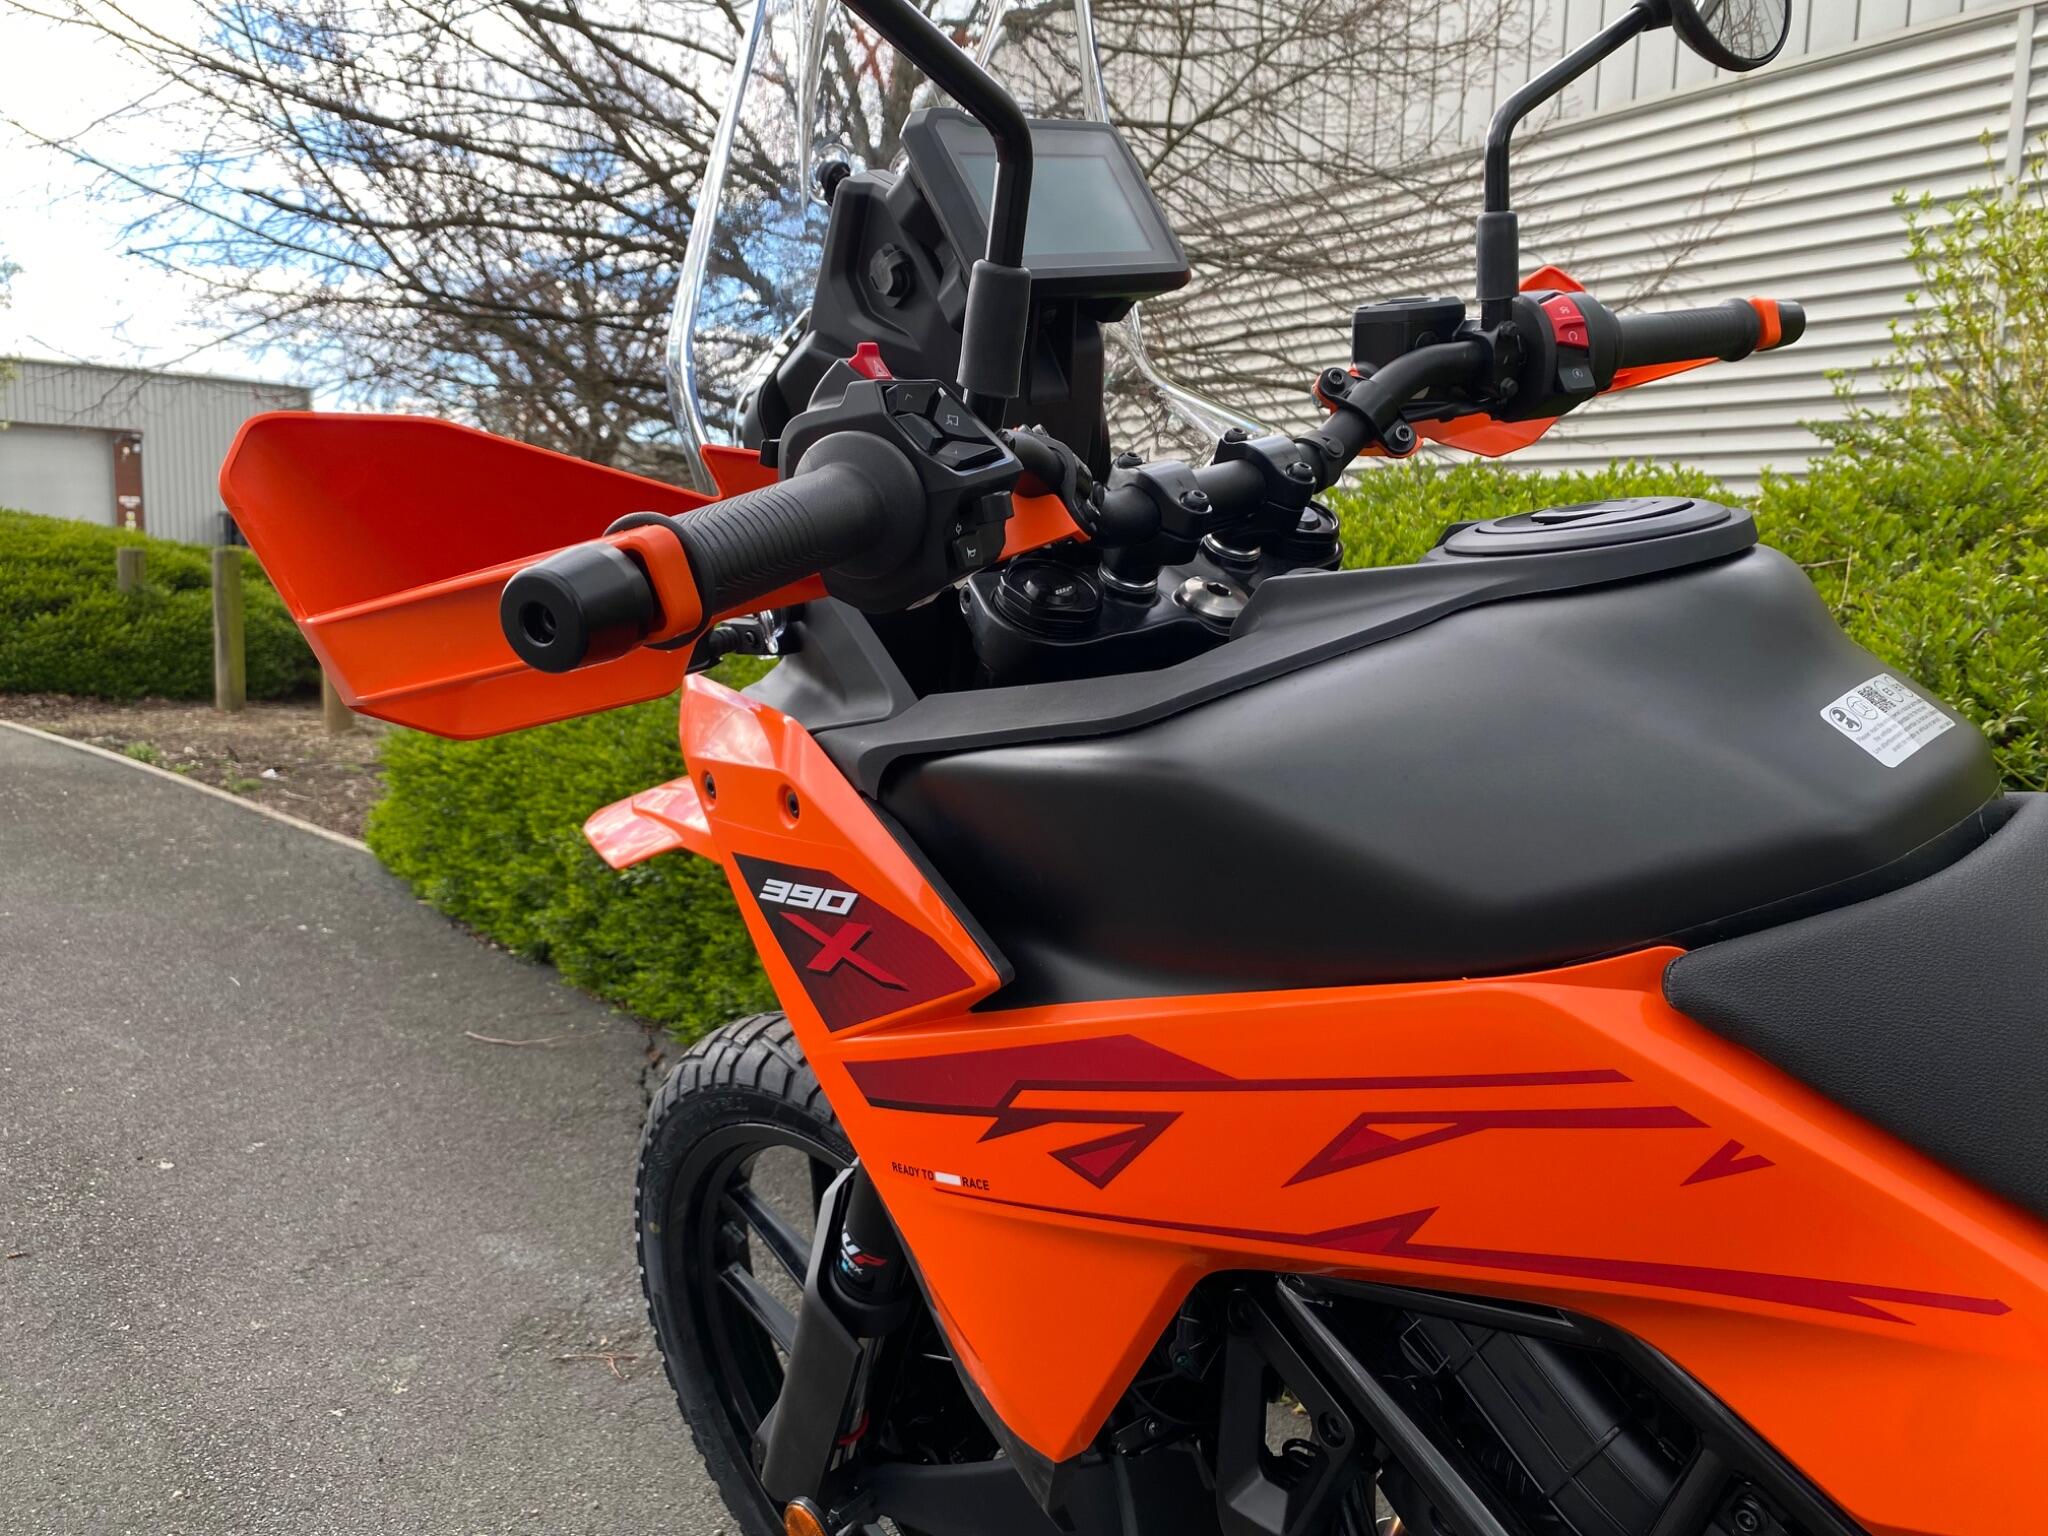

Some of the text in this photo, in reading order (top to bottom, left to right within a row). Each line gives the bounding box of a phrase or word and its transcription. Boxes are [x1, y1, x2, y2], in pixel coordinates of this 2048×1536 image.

[759, 878, 859, 916] 390
[779, 911, 909, 992] X
[891, 1161, 990, 1191] READY TO RACE
